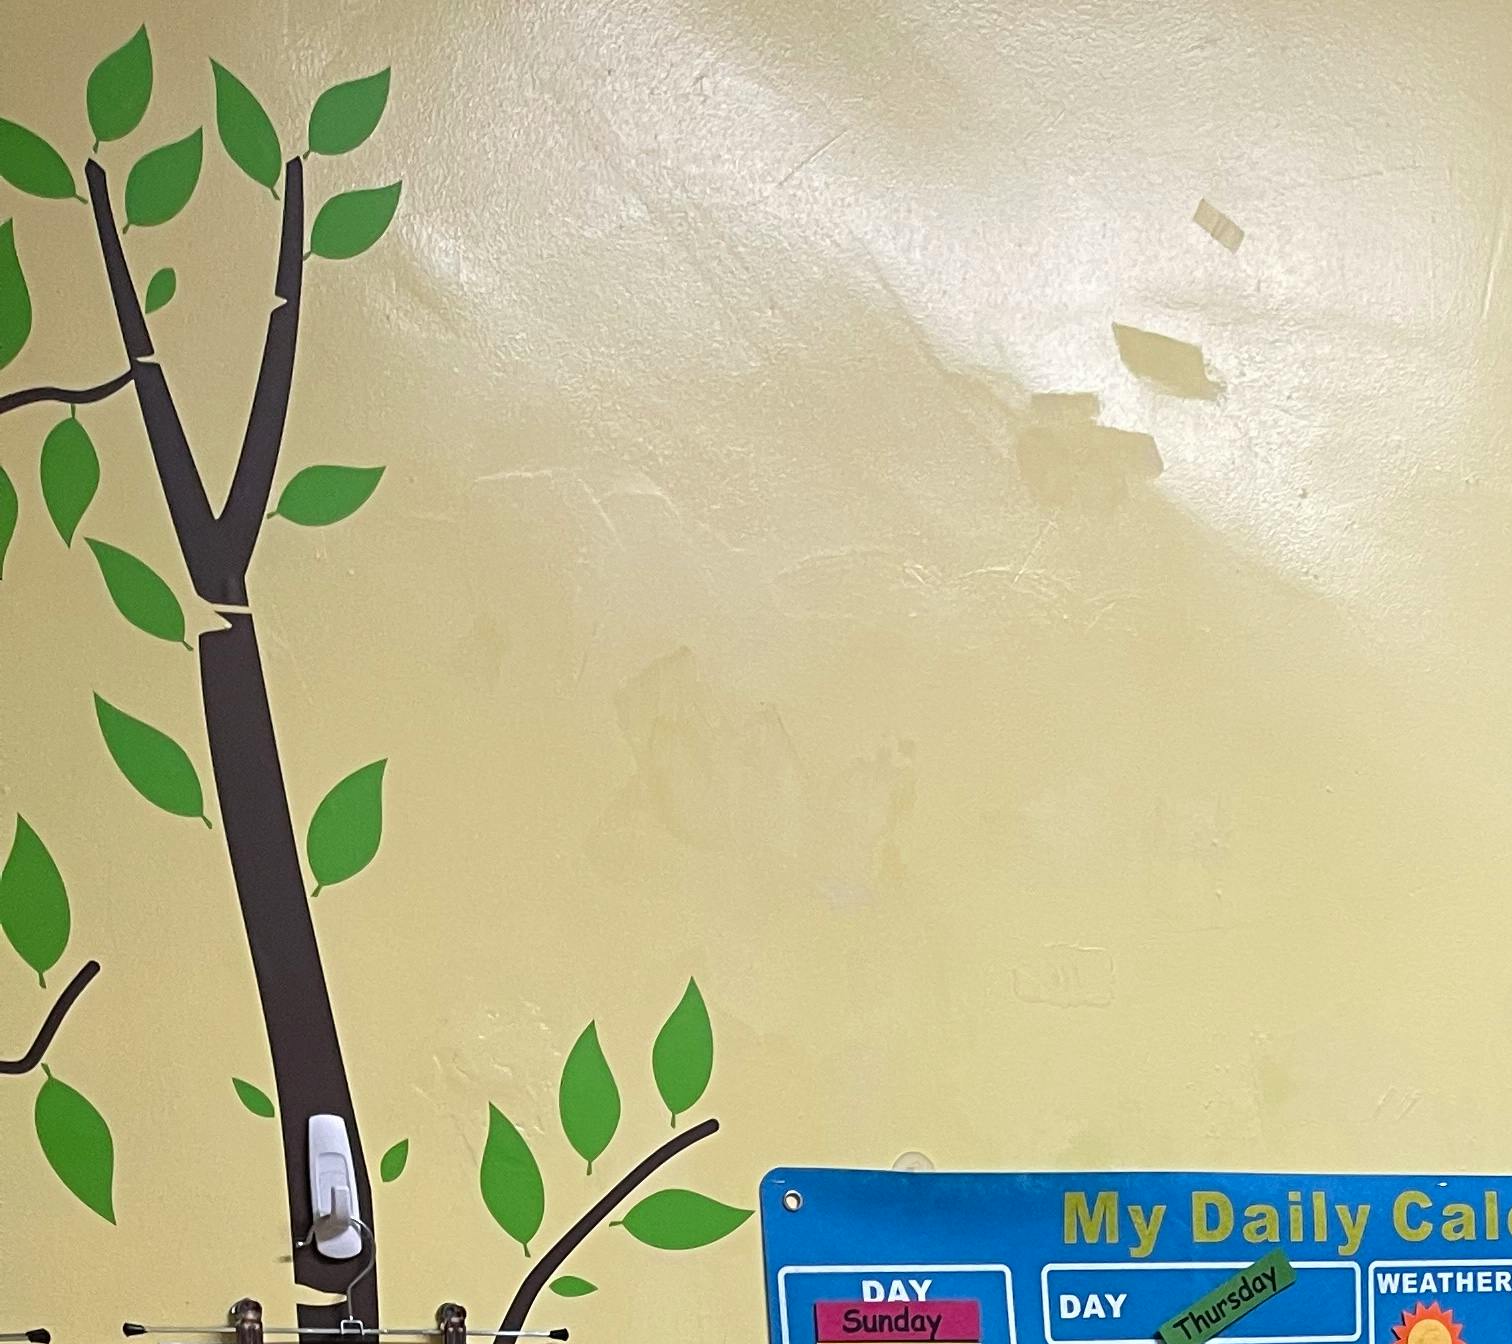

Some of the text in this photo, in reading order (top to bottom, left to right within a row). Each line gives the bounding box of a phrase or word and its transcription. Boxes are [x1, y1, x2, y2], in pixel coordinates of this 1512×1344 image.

[1063, 1192, 1166, 1258] My
[1192, 1191, 1369, 1255] Daily
[862, 1279, 932, 1302] DAY
[1376, 1271, 1512, 1295] WEATHER
[1059, 1294, 1127, 1320] DAY
[1172, 1264, 1280, 1343] Thursday
[843, 1306, 942, 1340] Sunday
